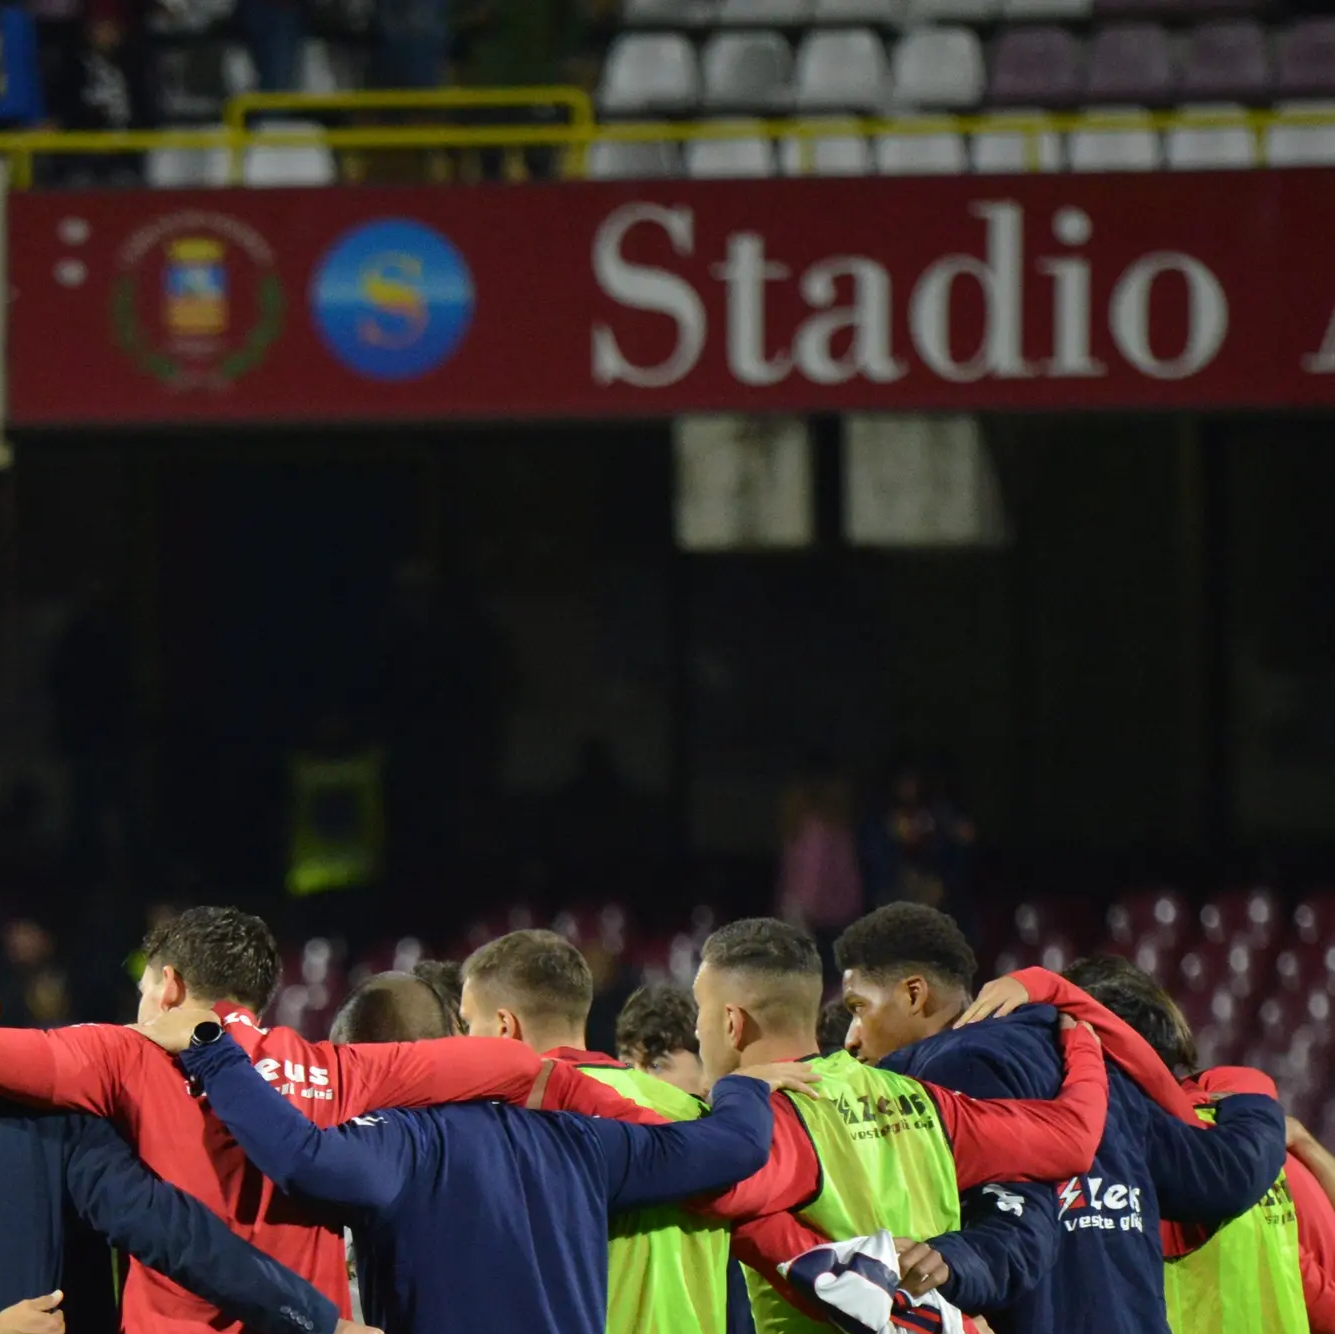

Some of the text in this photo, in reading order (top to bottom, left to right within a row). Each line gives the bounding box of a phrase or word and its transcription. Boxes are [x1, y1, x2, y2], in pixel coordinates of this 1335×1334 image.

[591, 199, 1229, 388] Stadio
[254, 1058, 329, 1086] eus
[1065, 1214, 1115, 1232] veste
